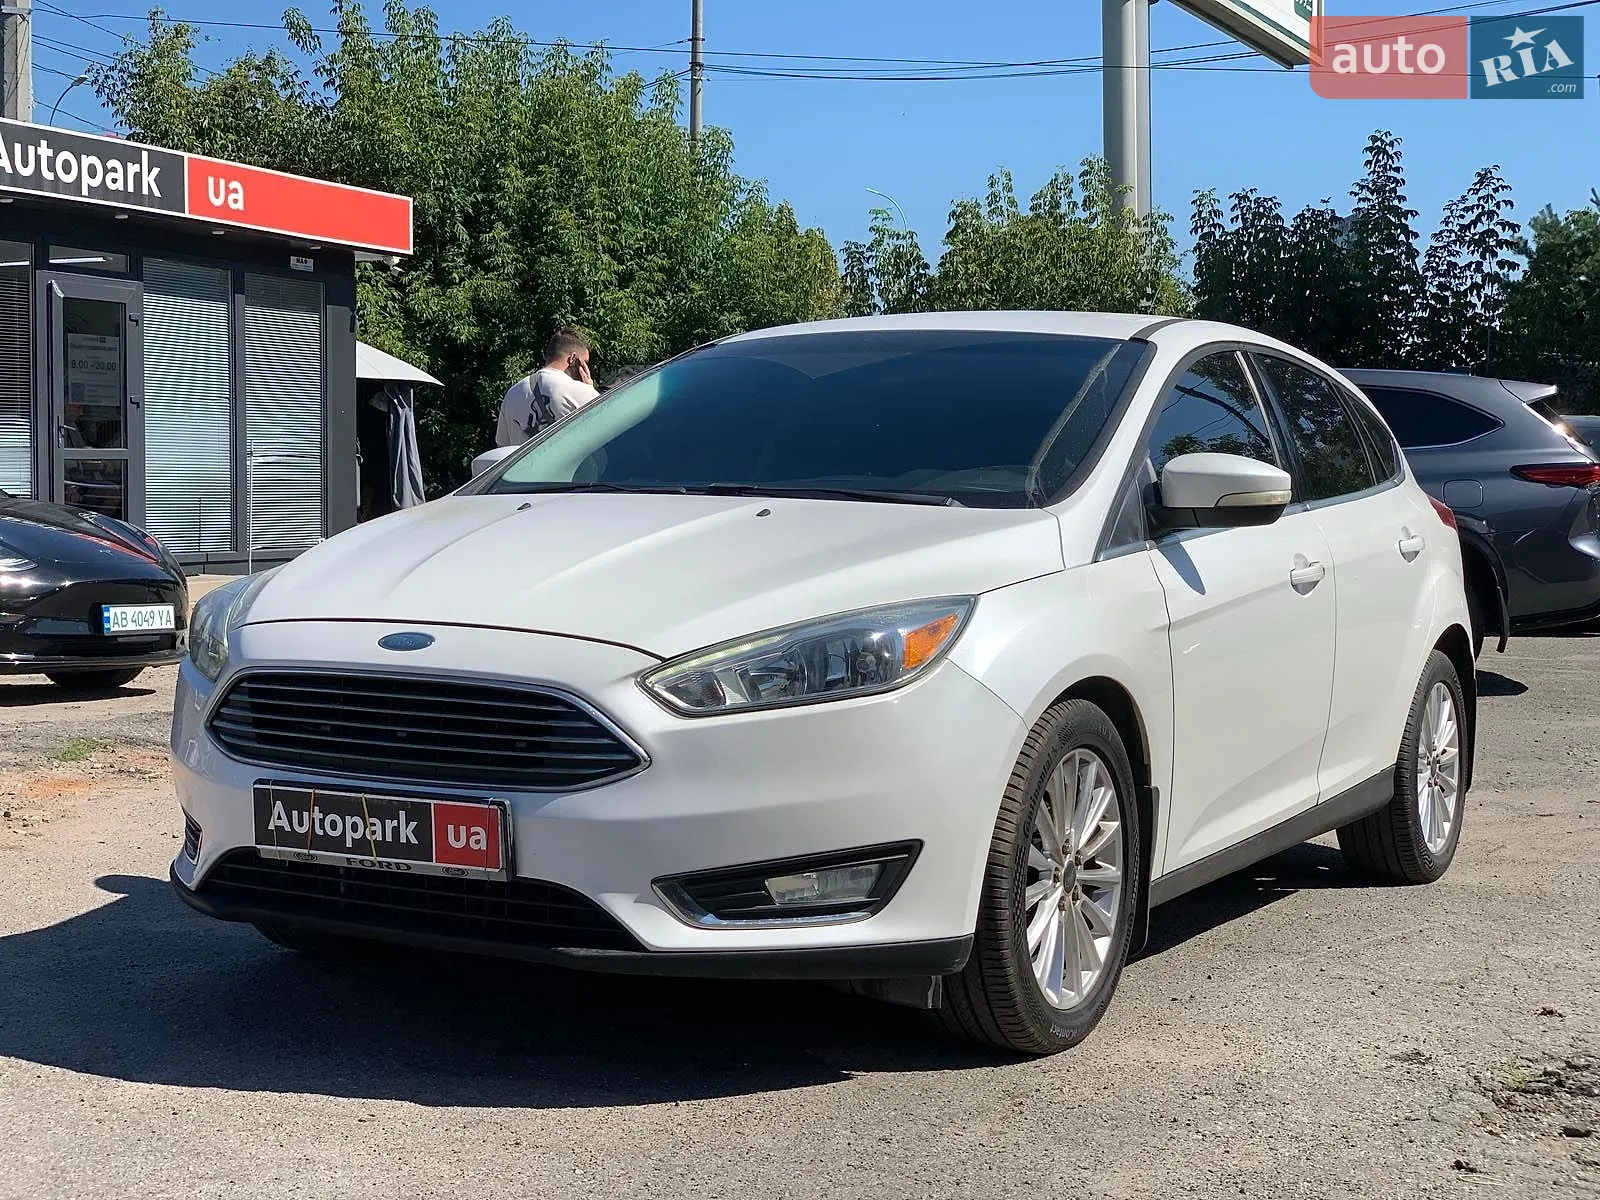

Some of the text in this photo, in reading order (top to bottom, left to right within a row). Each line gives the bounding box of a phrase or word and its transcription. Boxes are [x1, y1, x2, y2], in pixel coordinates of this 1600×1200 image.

[207, 175, 244, 211] ua
[112, 611, 128, 628] AB
[131, 610, 155, 627] 4049
[158, 609, 172, 626] YA
[267, 800, 487, 850] Autopark ua
[346, 857, 412, 872] FORD
